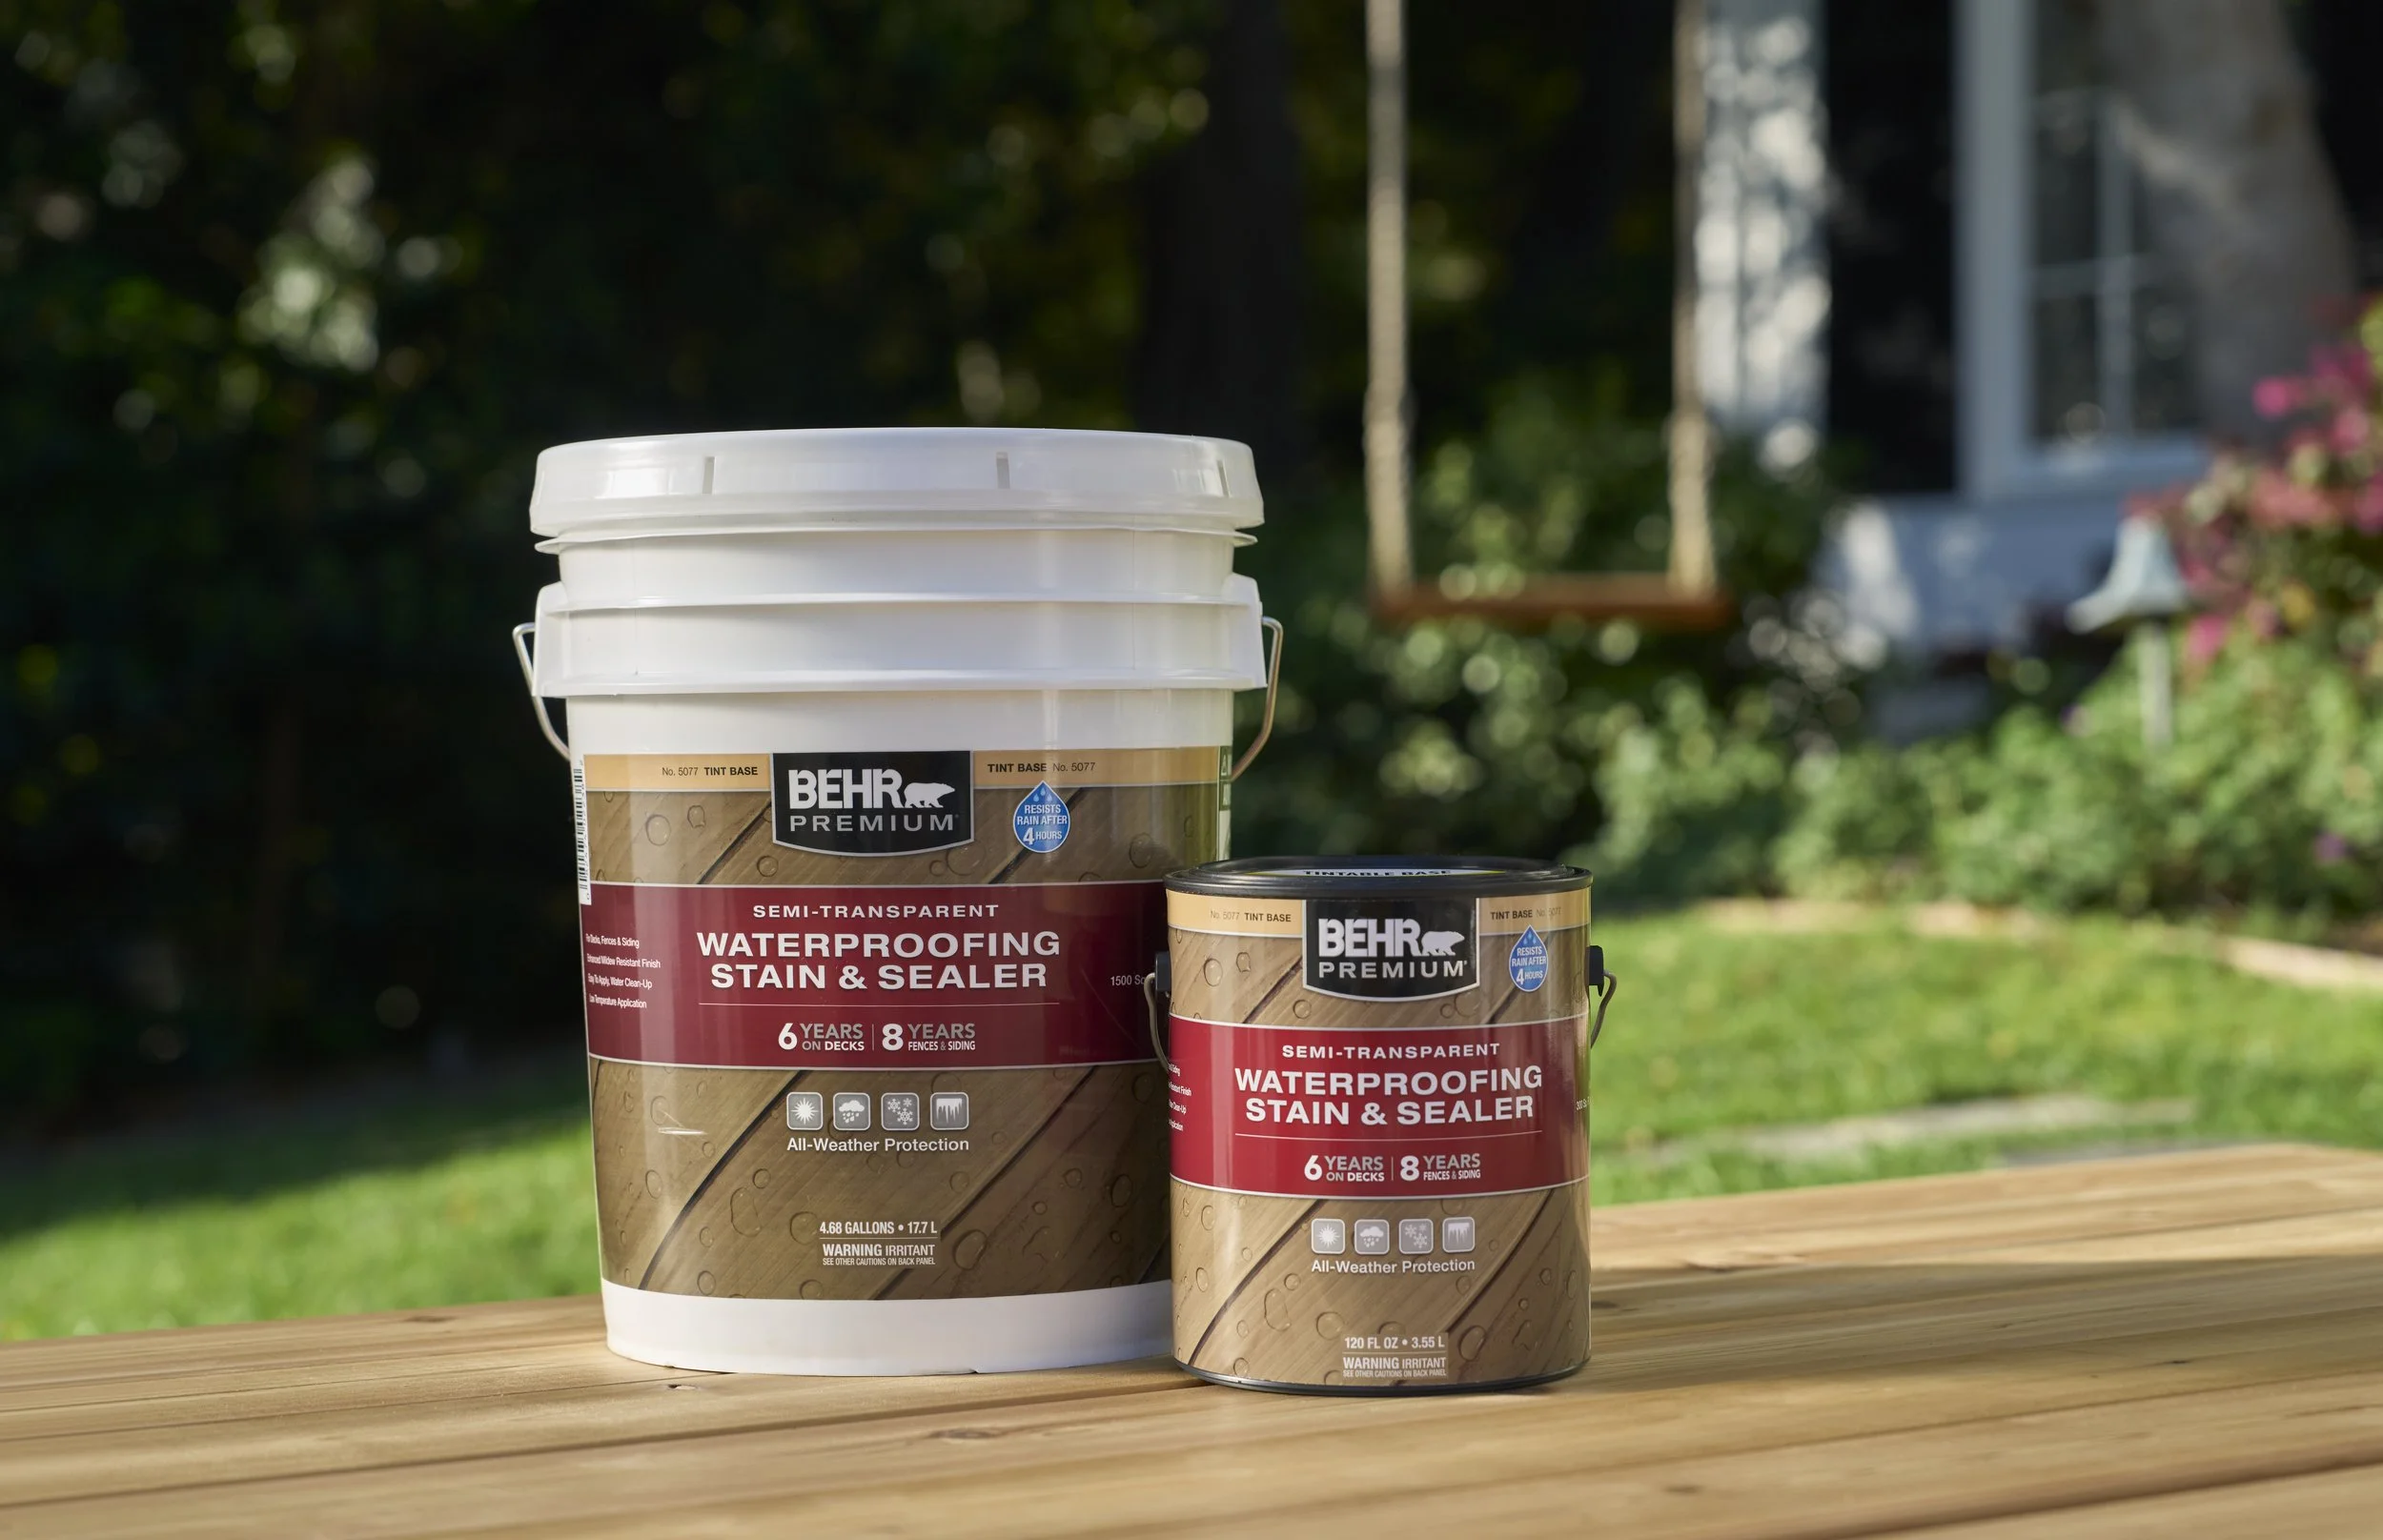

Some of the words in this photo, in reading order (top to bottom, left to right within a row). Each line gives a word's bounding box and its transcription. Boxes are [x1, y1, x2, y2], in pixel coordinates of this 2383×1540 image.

[662, 766, 676, 777] No.
[678, 766, 699, 777] 5077
[703, 766, 727, 776] TINT
[729, 766, 759, 776] BASE
[988, 762, 1014, 773] TINT
[1017, 762, 1048, 773] BASE
[1052, 762, 1069, 772] No.
[1070, 761, 1096, 772] 5077
[788, 768, 905, 810] BEHR
[1024, 803, 1062, 815] RESISTS
[789, 814, 953, 832] PREMIUM
[1016, 816, 1039, 825] RAIN
[1040, 815, 1068, 825] AFTER
[1023, 827, 1035, 845] 4
[1035, 831, 1063, 841] HOURS
[752, 904, 999, 919] SEMI-TRANSPARENT
[1210, 910, 1220, 920] No.
[1222, 911, 1240, 921] 5077
[1244, 912, 1264, 922] TINT
[1266, 913, 1292, 922] BASE
[1490, 911, 1510, 921] TINT
[1512, 909, 1534, 920] BASE
[601, 935, 617, 946] Fences
[617, 937, 621, 946] &
[621, 937, 640, 949] Siding
[696, 930, 1061, 959] WATERPROOFING
[1317, 918, 1424, 958] BEHR
[1517, 945, 1542, 957] RESISTS
[616, 957, 641, 967] Resistant
[642, 958, 662, 968] Finish
[1511, 957, 1528, 967] RAIN
[1528, 955, 1546, 965] AFTER
[711, 962, 826, 989] STAIN
[838, 964, 868, 990] &
[878, 962, 1047, 990] SEALER
[1318, 960, 1463, 979] PREMIUM
[1516, 967, 1525, 985] 4
[1524, 970, 1544, 981] HOURS
[610, 976, 624, 986] Water
[624, 978, 653, 990] Clean-Up
[1110, 975, 1132, 986] 1500
[617, 997, 647, 1009] Application
[778, 1023, 798, 1050] 6
[800, 1023, 864, 1040] YEARS
[882, 1023, 904, 1051] 8
[907, 1023, 976, 1040] YEARS
[802, 1041, 822, 1051] ON
[825, 1041, 865, 1051] DECKS
[907, 1041, 939, 1051] FENCES
[940, 1042, 947, 1051] &
[947, 1040, 976, 1051] SIDING
[1281, 1042, 1500, 1060] SEMI-TRANSPARENT
[1234, 1064, 1542, 1096] WATERPROOFING
[1245, 1097, 1350, 1125] STAIN
[1360, 1102, 1388, 1126] &
[1396, 1095, 1534, 1126] SEALER
[786, 1137, 880, 1152] All-Weather
[885, 1137, 969, 1152] Protection
[1304, 1154, 1323, 1182] 6
[1324, 1155, 1383, 1171] YEARS
[1400, 1155, 1420, 1182] 8
[1423, 1153, 1481, 1170] YEARS
[1423, 1170, 1450, 1181] FENCES
[1451, 1171, 1457, 1180] &
[1457, 1168, 1481, 1180] SIDING
[1326, 1172, 1344, 1182] ON
[1347, 1172, 1385, 1182] DECKS
[819, 1221, 843, 1234] 4.68
[845, 1221, 895, 1234] GALLONS
[907, 1221, 928, 1234] 17.7
[930, 1221, 938, 1234] L
[823, 1244, 883, 1257] WARNING
[886, 1244, 935, 1256] IRRITANT
[823, 1257, 834, 1266] SEE
[835, 1257, 855, 1266] OTHER
[856, 1257, 886, 1266] CAUTIONS
[887, 1257, 897, 1266] ON
[898, 1257, 915, 1266] BACK
[916, 1257, 935, 1266] PANEL
[1311, 1259, 1397, 1274] All-Weather
[1402, 1258, 1476, 1273] Protection
[1344, 1336, 1364, 1349] 120
[1367, 1336, 1380, 1349] FL
[1383, 1336, 1398, 1349] OZ
[1411, 1336, 1436, 1348] 3.55
[1437, 1335, 1445, 1348] L
[1342, 1356, 1399, 1369] WARNING
[1402, 1357, 1446, 1368] IRRITANT
[1342, 1369, 1354, 1378] SEE
[1354, 1369, 1374, 1378] OTHER
[1374, 1369, 1403, 1378] CAUTIONS
[1429, 1368, 1447, 1377] PANEL
